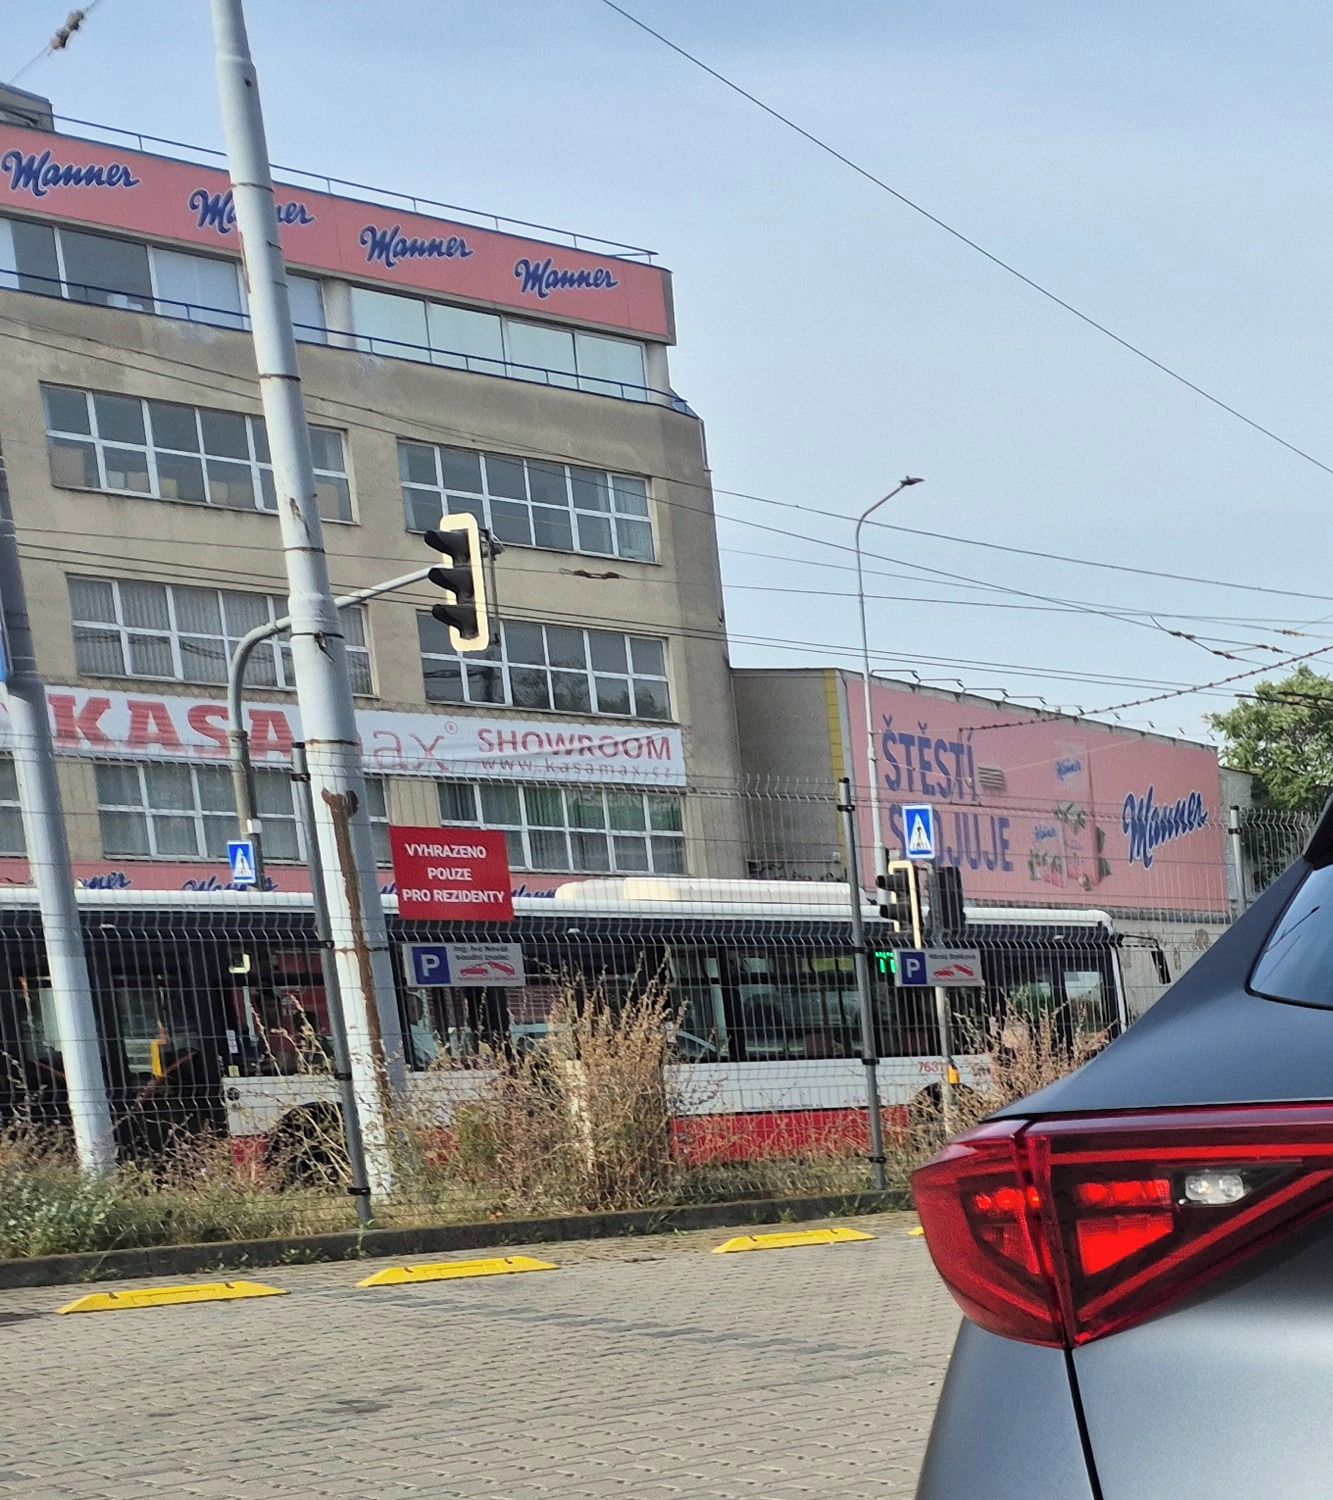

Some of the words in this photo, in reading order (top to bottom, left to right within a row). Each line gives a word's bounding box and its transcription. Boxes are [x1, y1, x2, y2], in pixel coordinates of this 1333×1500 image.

[2, 149, 141, 197] Manner
[359, 224, 473, 269] Manner
[514, 258, 618, 299] Manner
[478, 728, 672, 761] SHOWROOM
[882, 714, 977, 801] ŠTĚSTÍ
[889, 803, 1014, 873] SOJUJE
[1122, 784, 1208, 870] Manner
[405, 843, 487, 859] VYHRAZENO
[427, 867, 473, 881] POUZE
[402, 888, 431, 902] PRO
[435, 889, 505, 903] REZIDENTY
[421, 954, 440, 977] P
[906, 958, 920, 978] P
